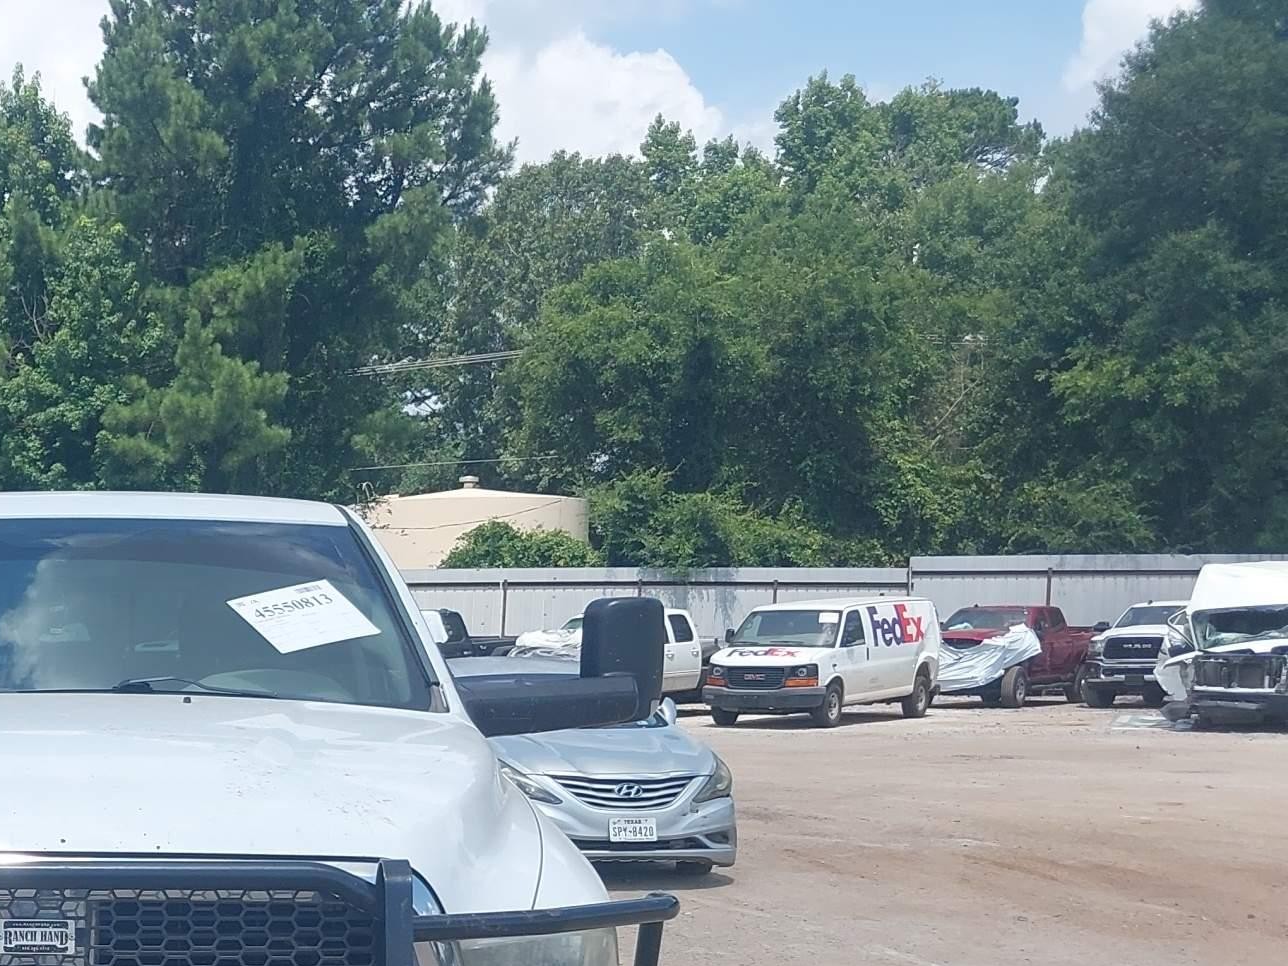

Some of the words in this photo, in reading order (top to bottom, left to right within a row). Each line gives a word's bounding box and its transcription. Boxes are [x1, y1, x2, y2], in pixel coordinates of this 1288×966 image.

[254, 593, 334, 619] 45550813
[866, 603, 925, 648] FedEx
[726, 647, 800, 658] FedEx
[4, 930, 38, 945] RANCH
[40, 930, 69, 946] HAND
